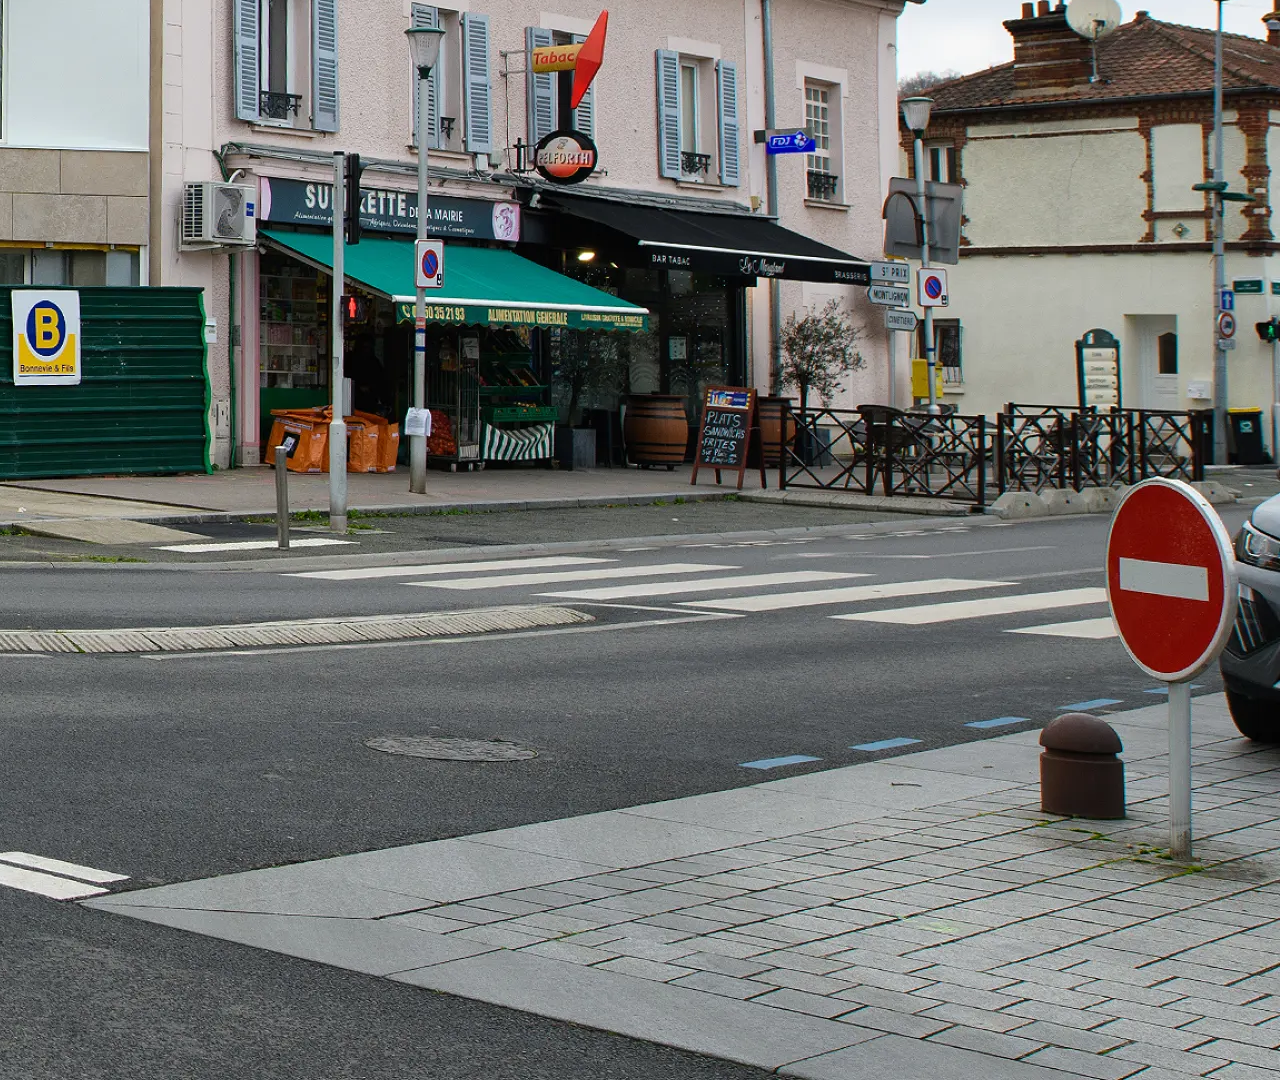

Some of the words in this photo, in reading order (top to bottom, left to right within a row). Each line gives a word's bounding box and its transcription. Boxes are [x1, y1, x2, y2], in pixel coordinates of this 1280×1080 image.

[534, 51, 575, 65] Tabac
[772, 137, 791, 146] FDJ
[539, 151, 590, 165] PELFORTH
[434, 209, 464, 222] MAIRIE
[652, 254, 667, 263] BAR
[668, 255, 690, 266] TABAC
[834, 270, 868, 281] BRASSERIE
[891, 267, 907, 278] PRIX
[873, 289, 908, 303] MONTLIGNON
[445, 307, 454, 320] 21
[455, 307, 465, 320] 93
[488, 308, 535, 324] ALIMENTATION
[35, 307, 60, 349] B
[20, 365, 52, 373] Bonnevie
[54, 365, 59, 373] &
[61, 365, 74, 373] Fils
[707, 411, 742, 428] PLATS
[703, 437, 737, 451] FRITES
